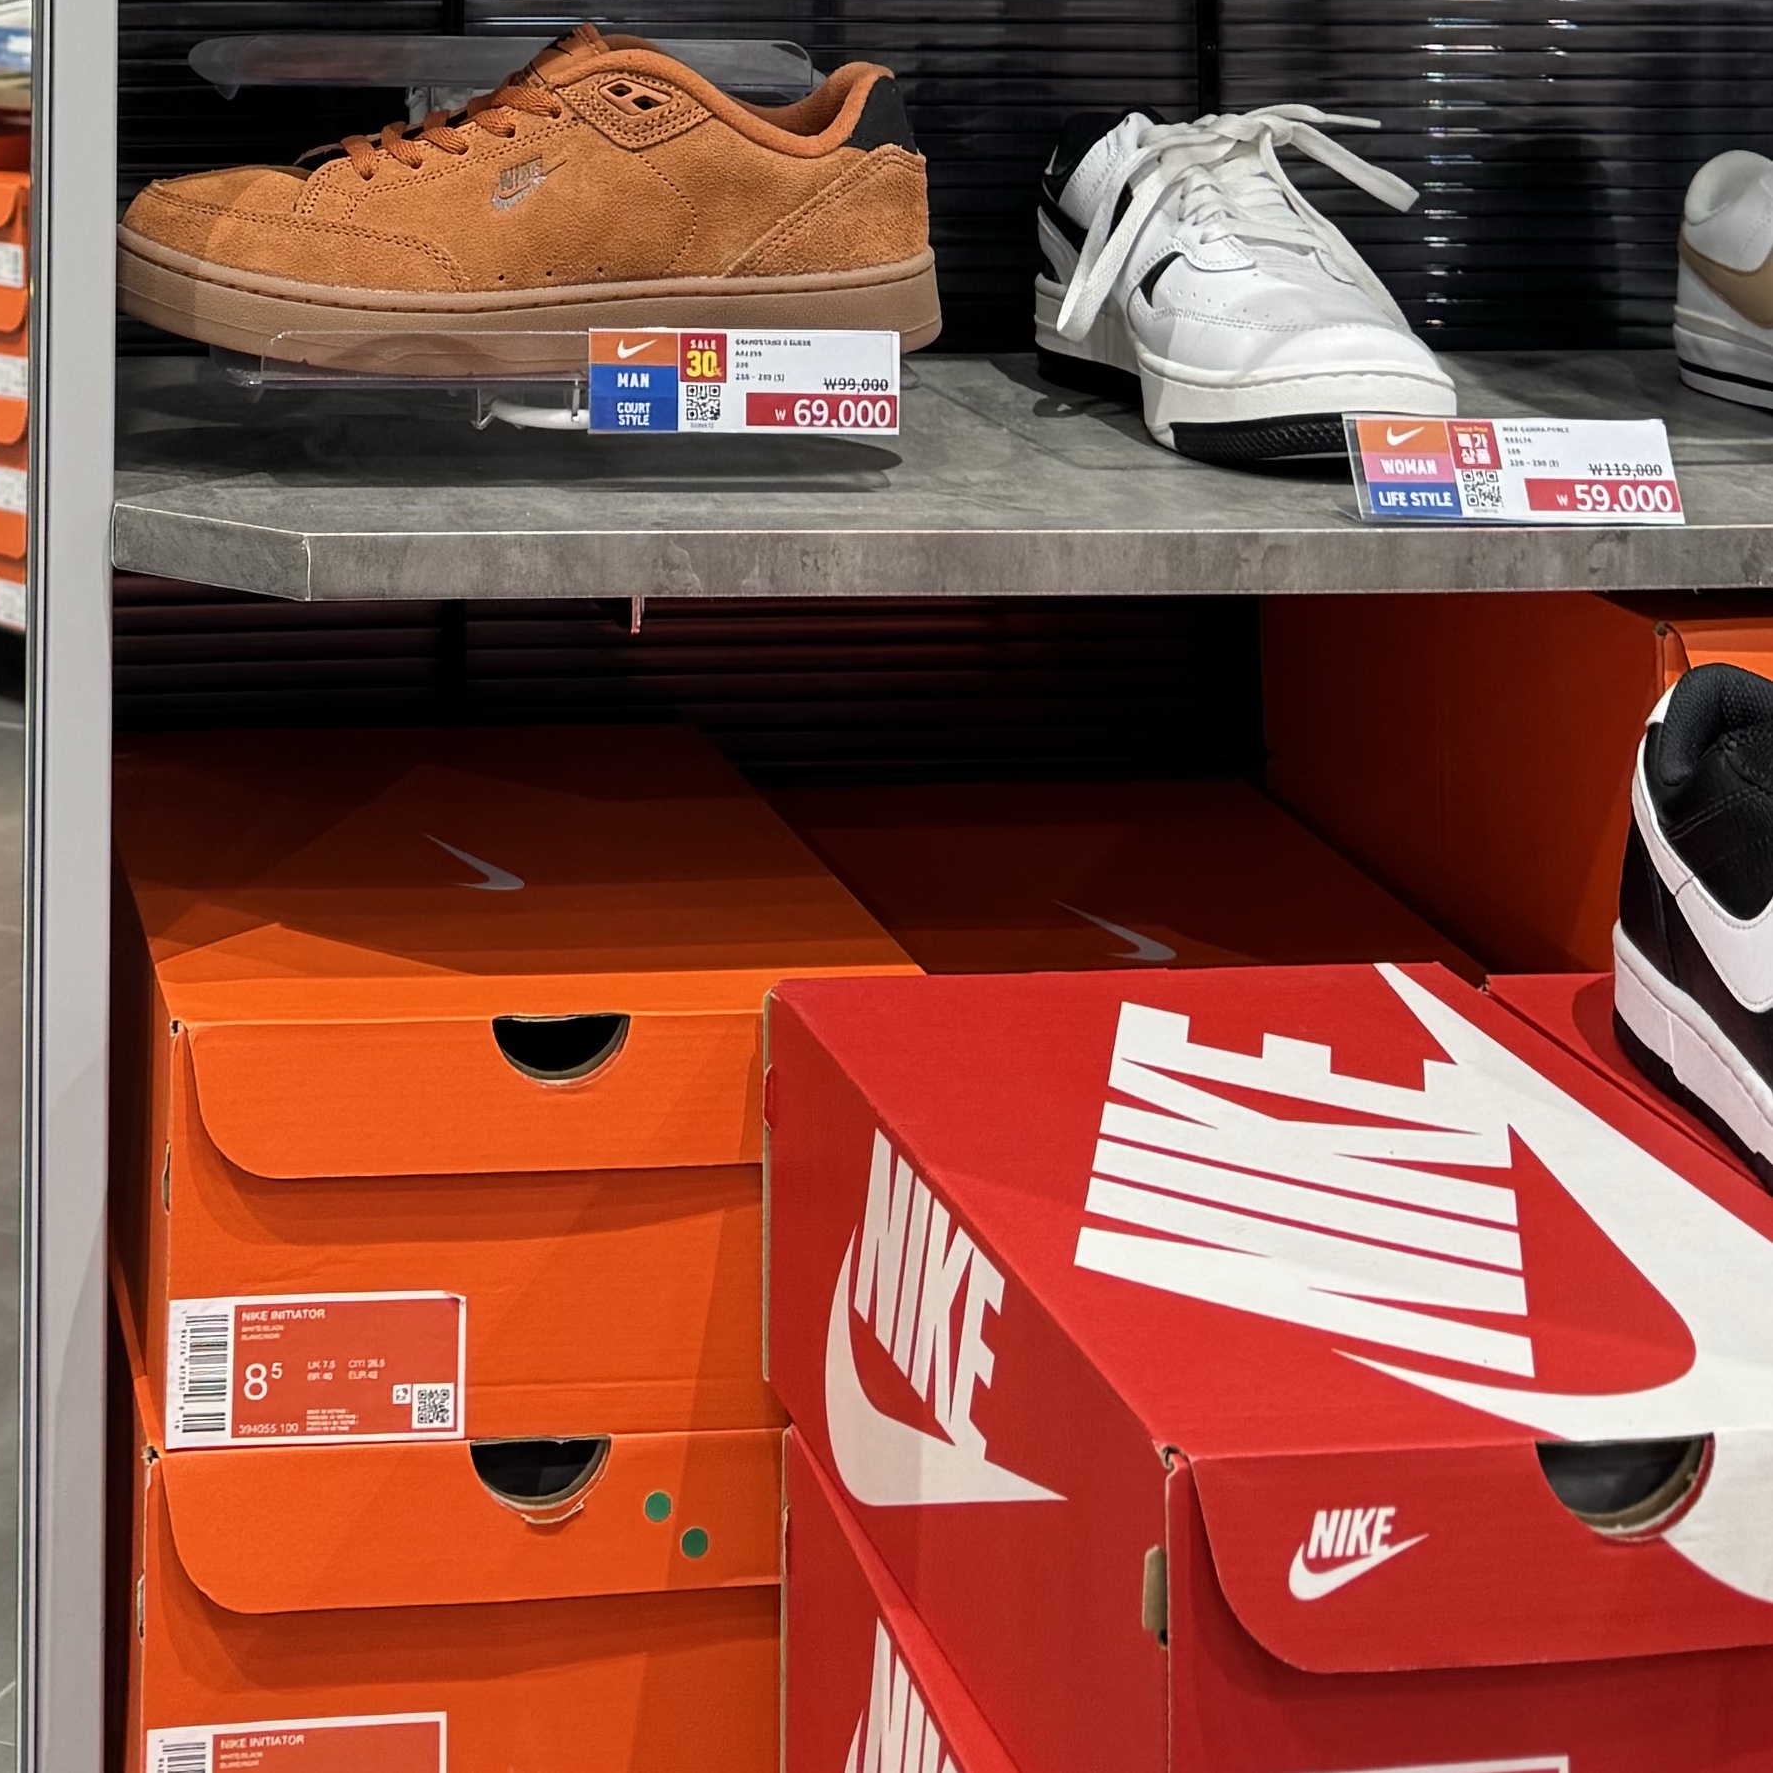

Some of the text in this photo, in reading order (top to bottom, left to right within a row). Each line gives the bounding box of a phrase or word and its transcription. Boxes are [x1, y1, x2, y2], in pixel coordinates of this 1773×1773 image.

[689, 339, 716, 349] SALE
[617, 373, 650, 388] MAN
[616, 402, 651, 414] COURT
[793, 398, 891, 428] 69,000
[618, 414, 650, 427] STYLE
[1457, 432, 1488, 449] 특가
[1461, 448, 1491, 465] 상품
[1381, 459, 1438, 475] WOMAN
[1378, 491, 1453, 507] LIFE STYLE
[1574, 484, 1673, 513] 59,000
[1074, 1002, 1534, 1377] NIKE
[853, 1127, 1005, 1440] NIKE
[242, 1308, 325, 1322] NIKE INITIATOR
[1307, 1507, 1396, 1558] NIKE
[220, 1735, 304, 1749] NIKE INITIATOR
